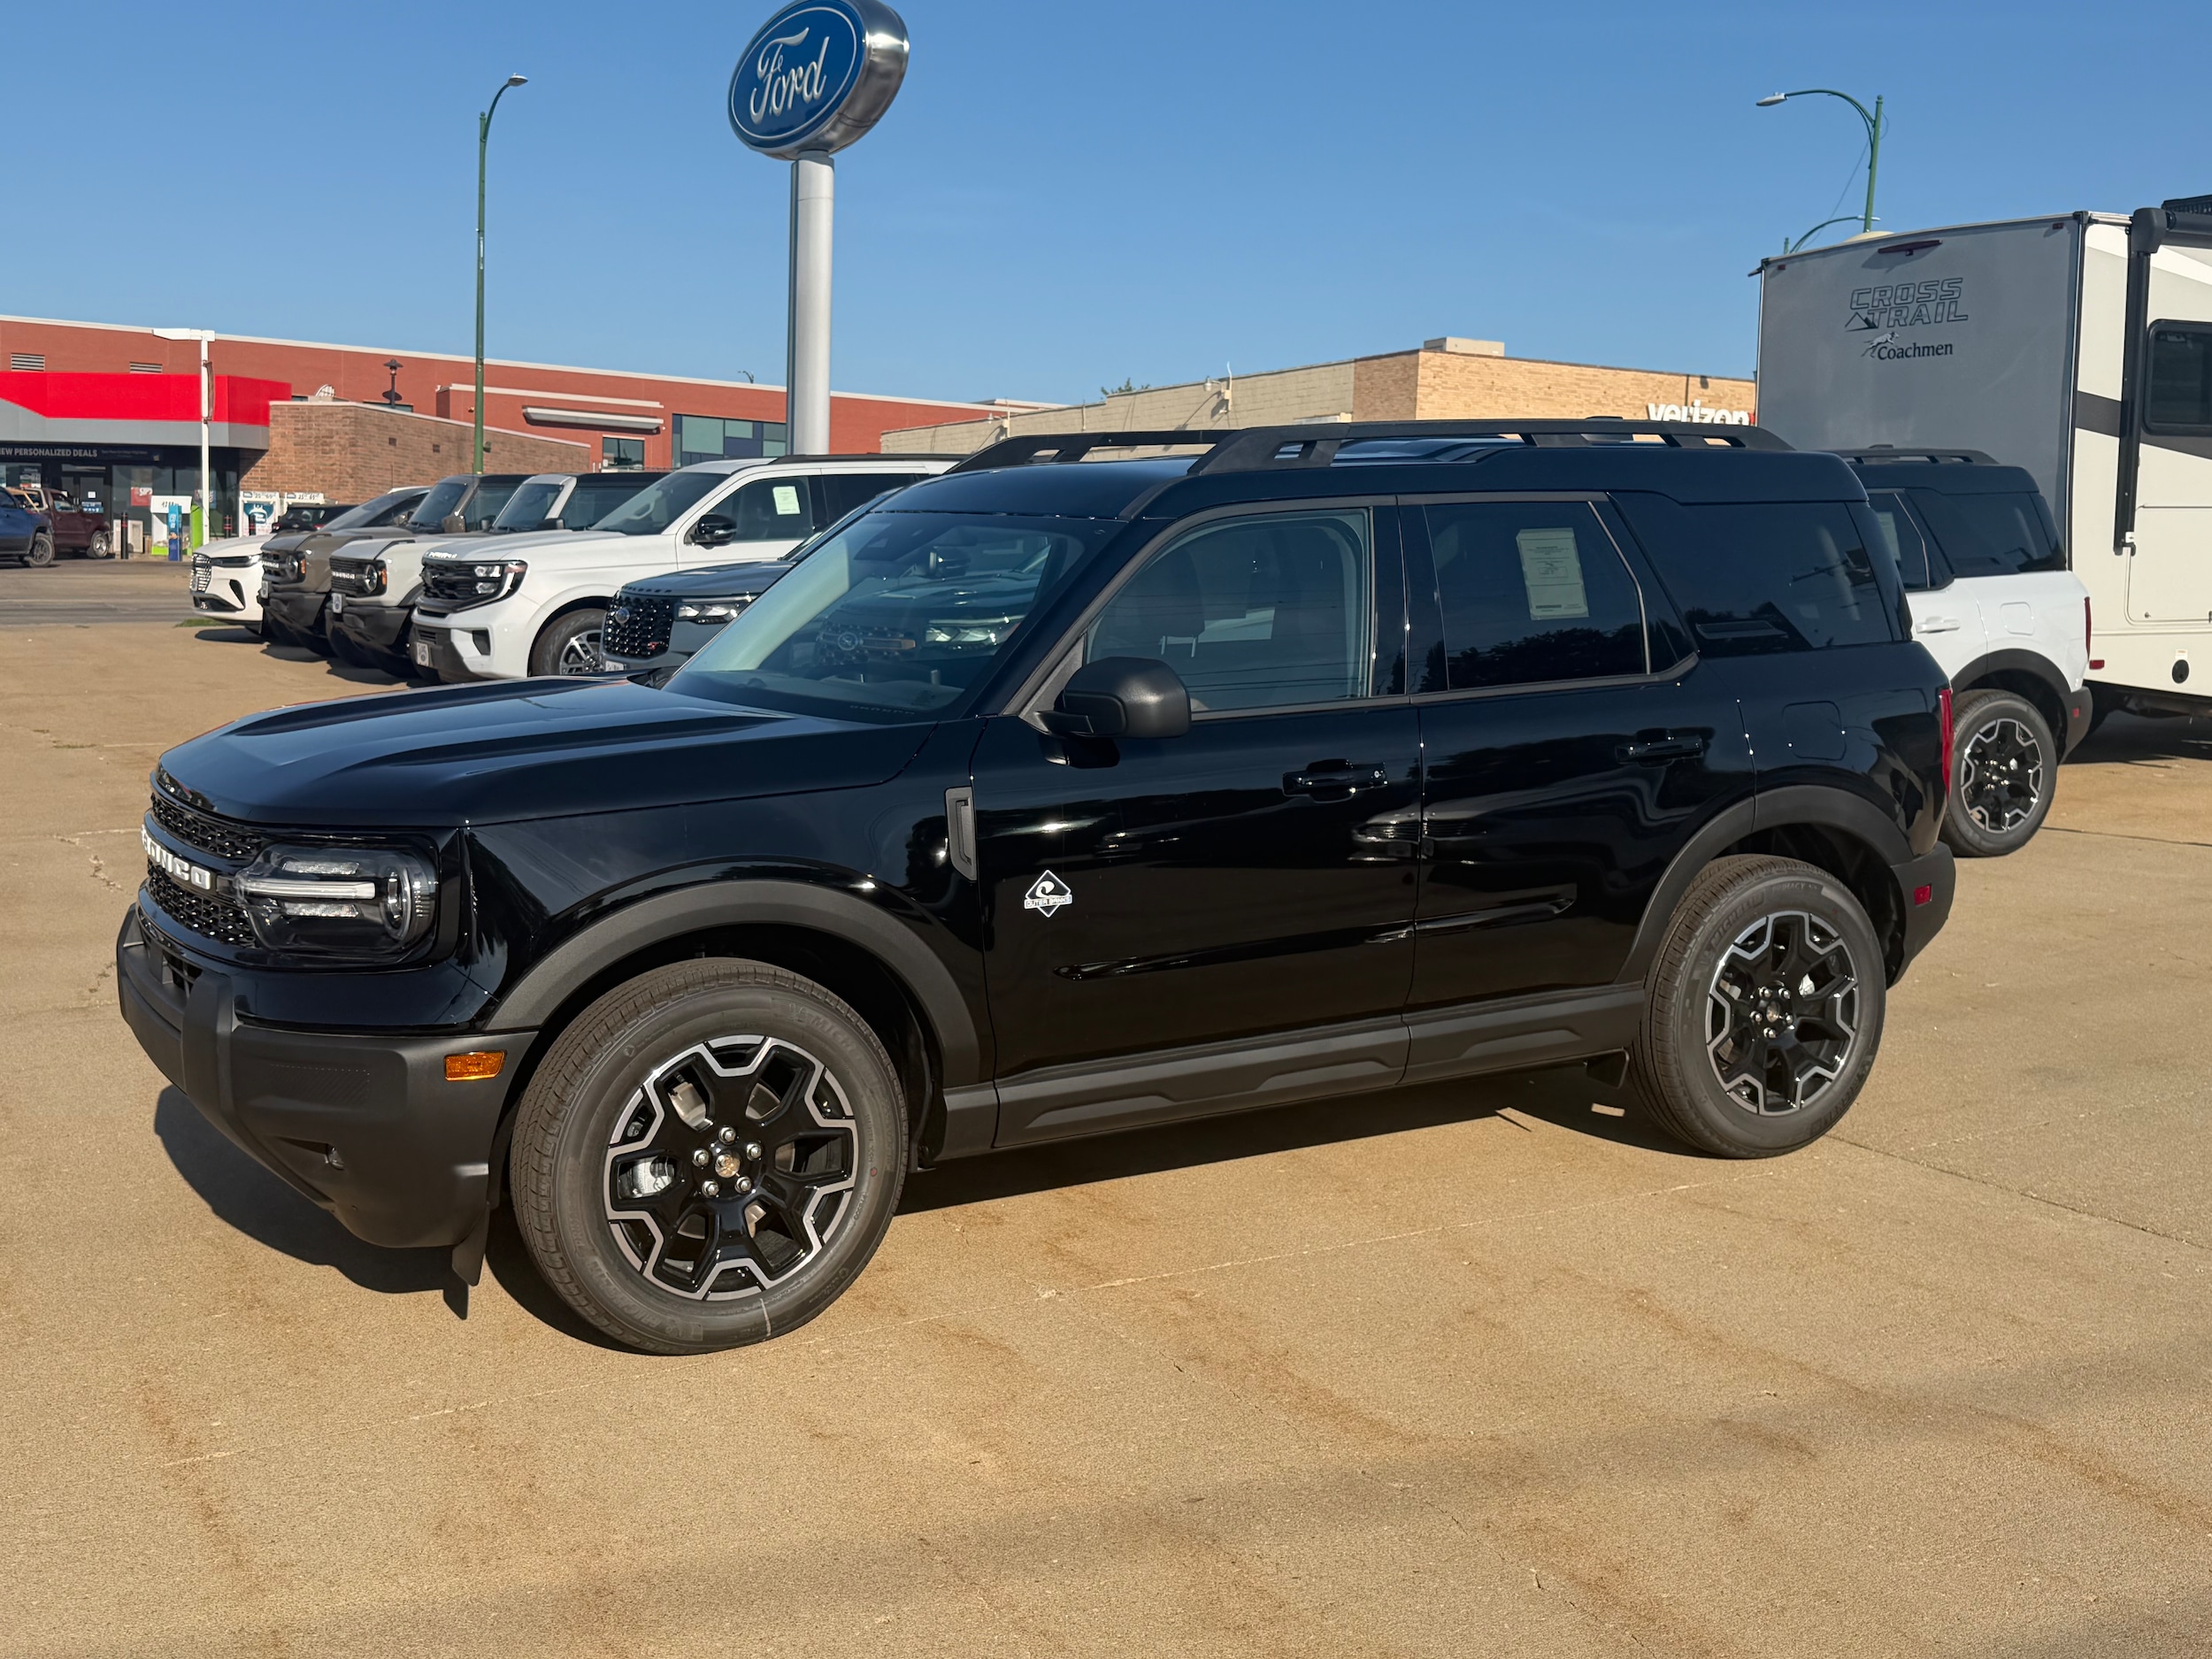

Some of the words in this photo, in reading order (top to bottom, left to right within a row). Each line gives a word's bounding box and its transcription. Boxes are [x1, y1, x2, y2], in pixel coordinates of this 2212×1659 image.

[749, 27, 830, 124] Ford
[1850, 277, 1963, 310] CROSS
[1867, 301, 1969, 328] TRAIL
[1877, 342, 1954, 360] Coachmen
[1647, 398, 1750, 426] verizon
[14, 448, 72, 457] PERSONALIZED
[73, 449, 97, 457] DEALS
